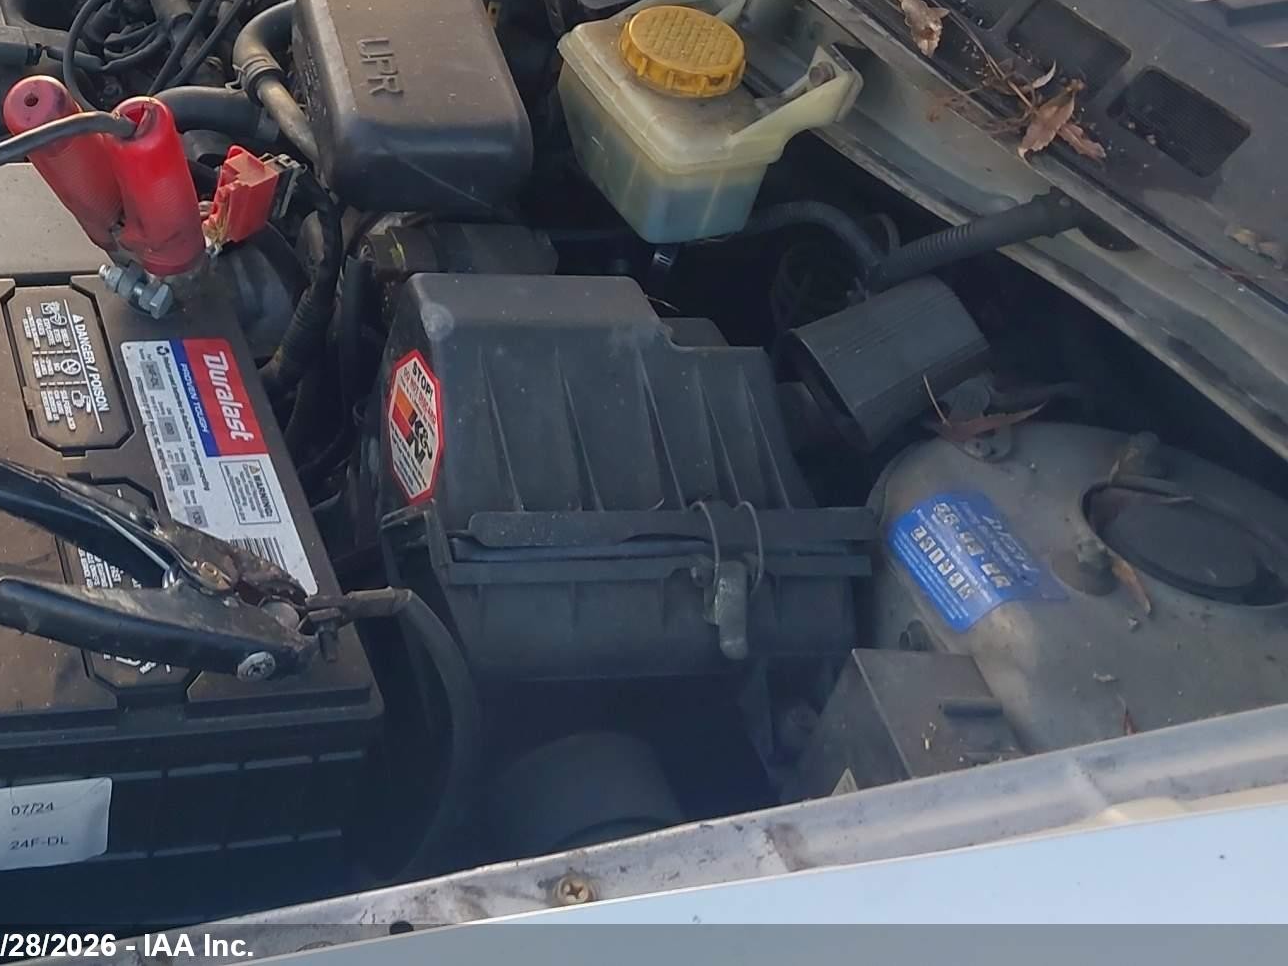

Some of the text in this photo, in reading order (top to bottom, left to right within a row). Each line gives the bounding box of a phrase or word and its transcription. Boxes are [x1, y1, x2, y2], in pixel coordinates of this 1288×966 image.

[75, 324, 96, 364] DANGER
[89, 372, 109, 412] POISON
[412, 361, 433, 401] STOP!
[180, 363, 208, 433] PROVEN TOUGH
[203, 351, 254, 442] Duralast
[11, 802, 55, 816] 07/24
[9, 835, 70, 850] 24F-DL
